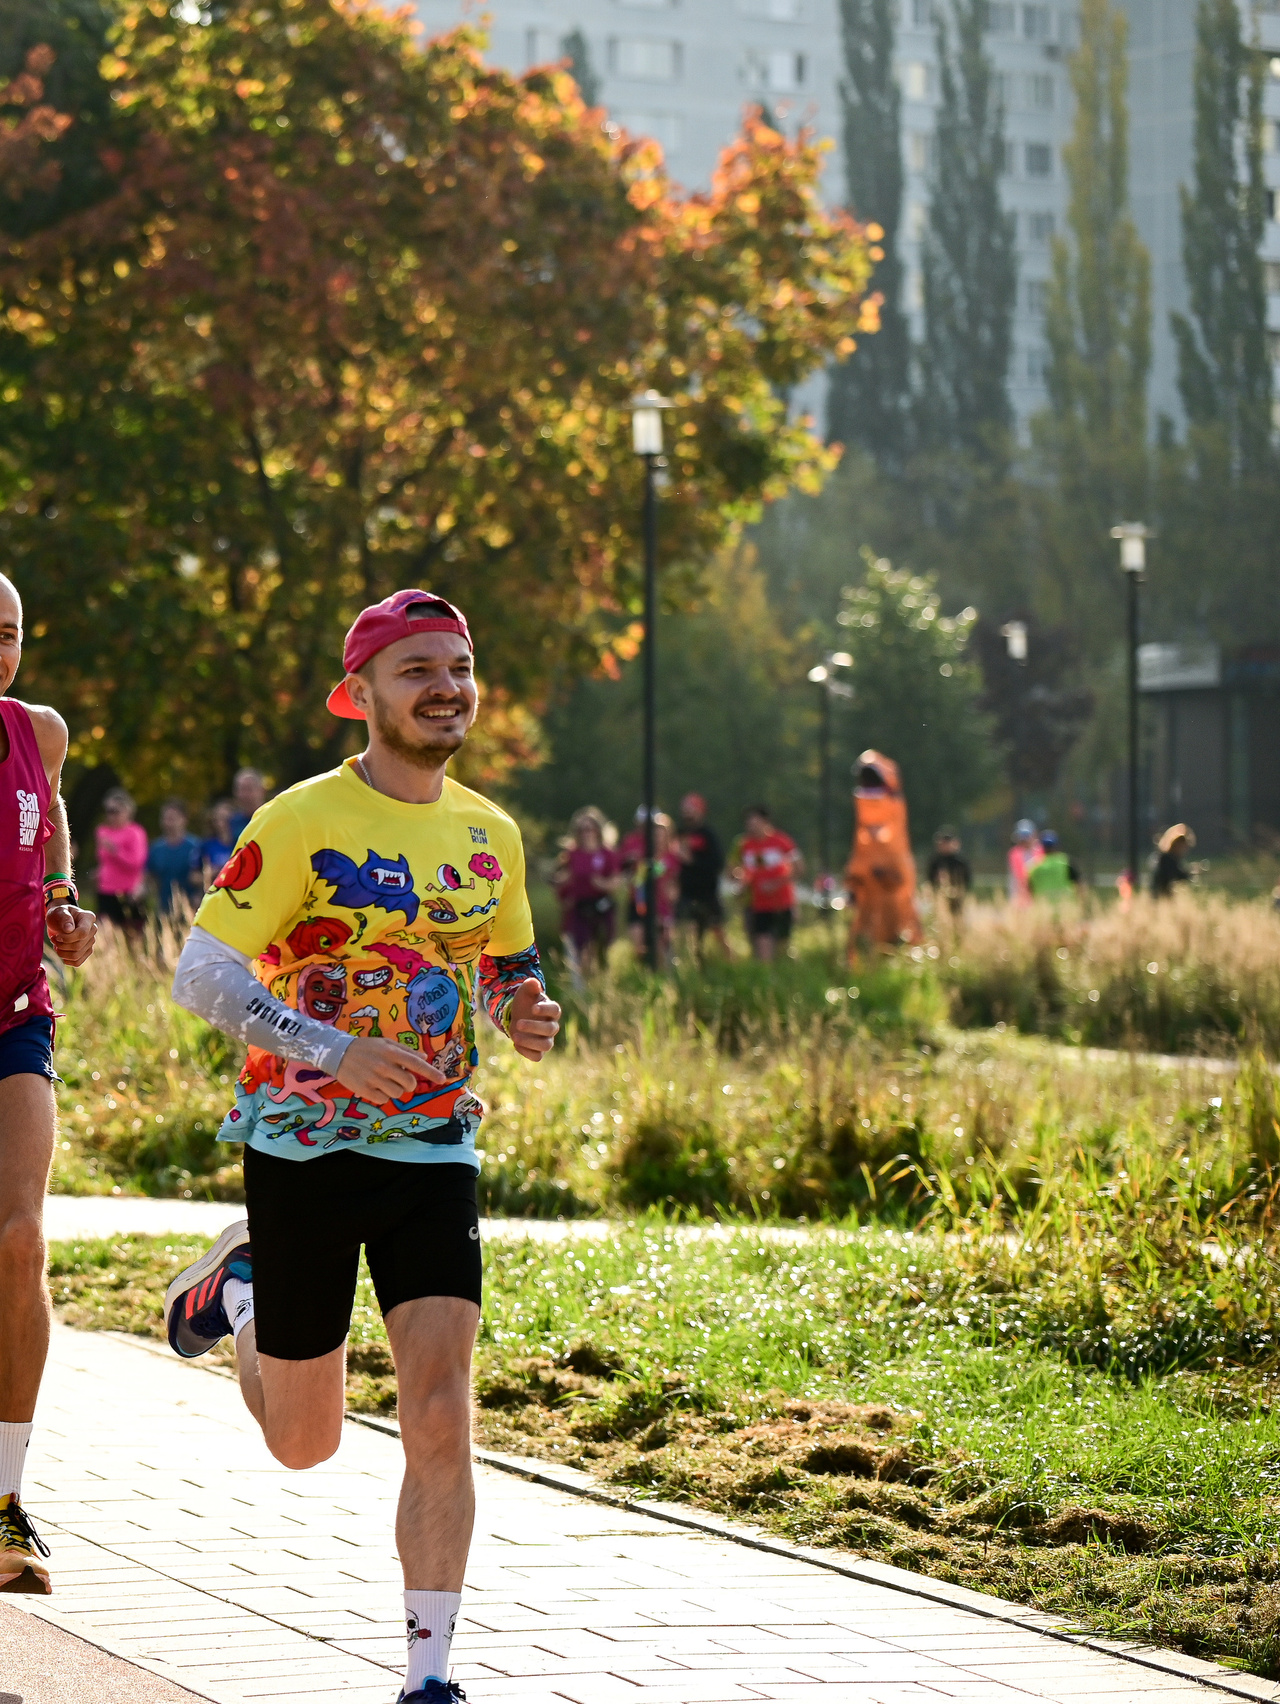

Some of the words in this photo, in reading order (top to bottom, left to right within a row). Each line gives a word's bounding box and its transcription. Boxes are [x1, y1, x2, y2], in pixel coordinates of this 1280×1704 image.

[16, 790, 40, 812] Sat
[19, 811, 40, 829] 9AM
[19, 828, 37, 846] 5KM
[467, 826, 487, 836] THAI
[471, 835, 488, 845] RUN
[246, 998, 302, 1036] IZMYLONG
